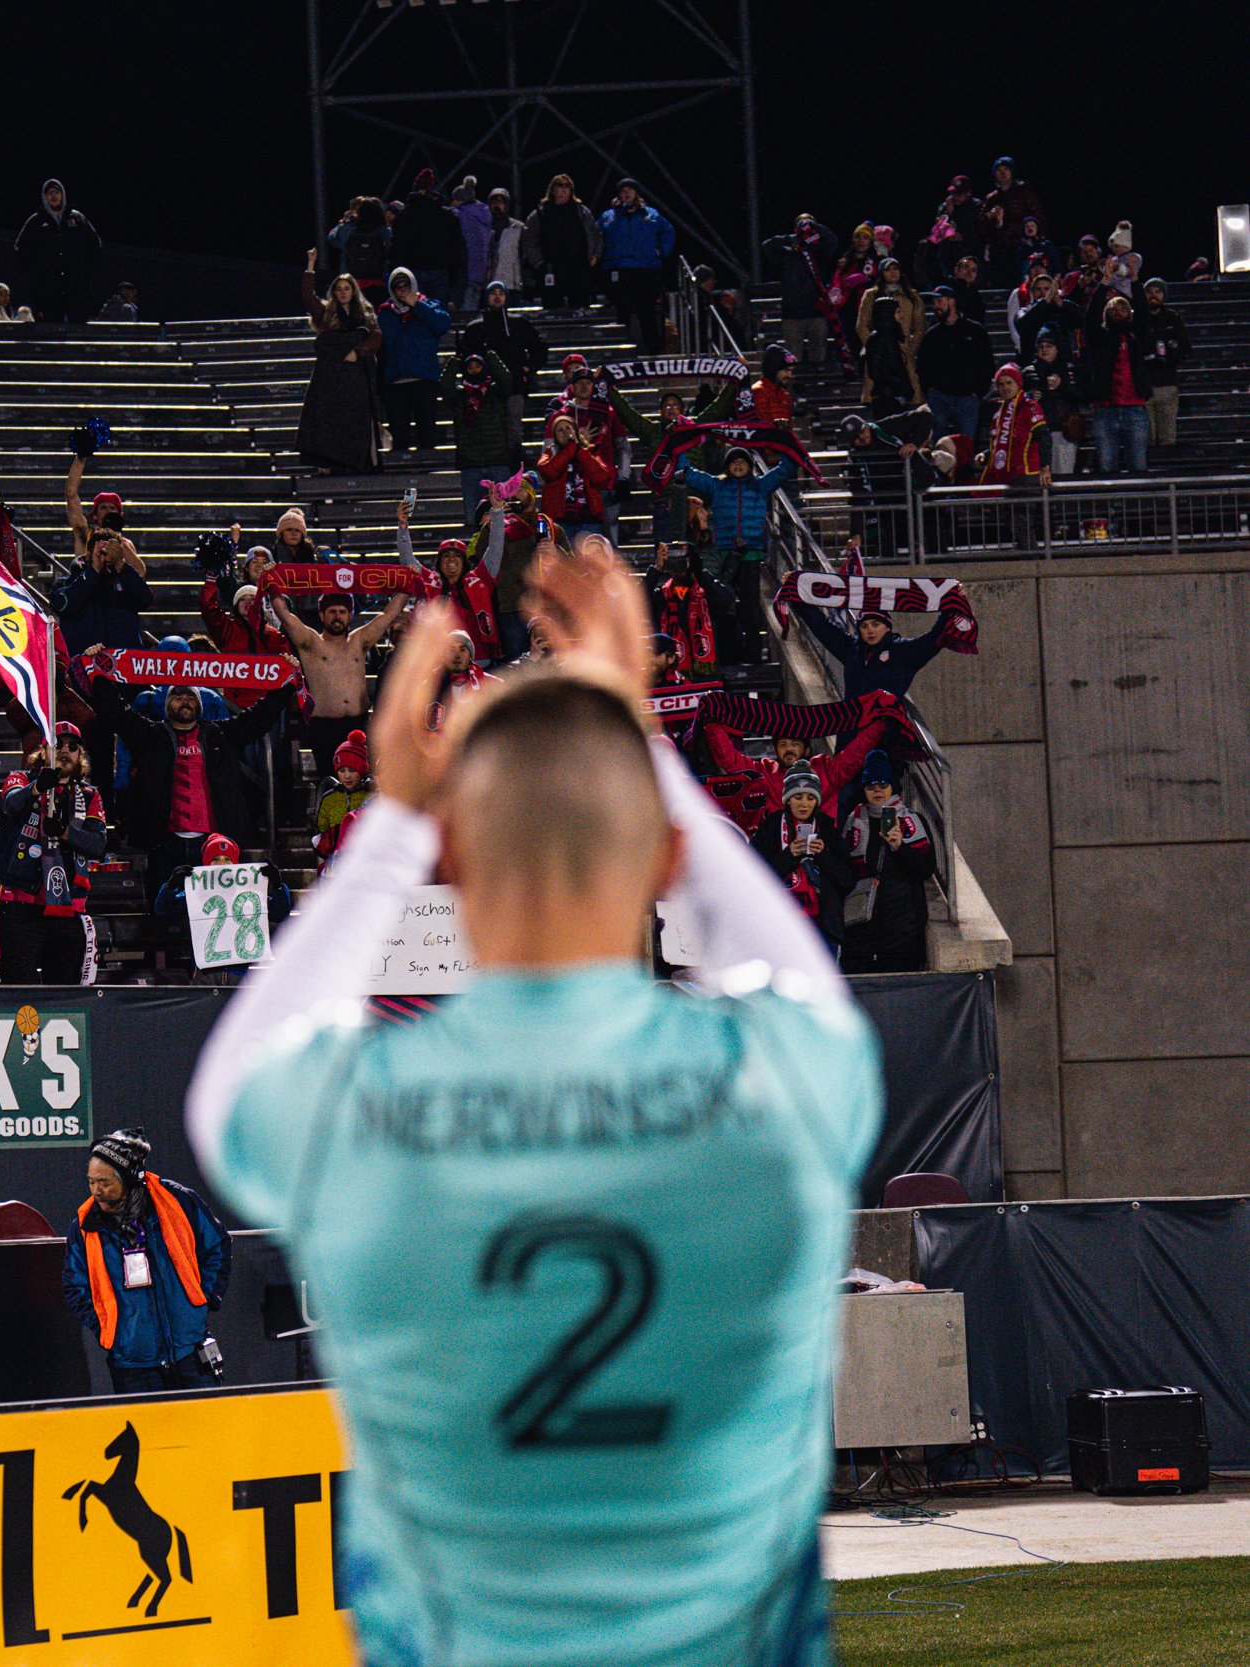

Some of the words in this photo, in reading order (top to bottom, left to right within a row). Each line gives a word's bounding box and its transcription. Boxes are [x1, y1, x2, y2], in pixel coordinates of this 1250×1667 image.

[338, 573, 354, 583] FOR
[797, 572, 958, 612] CITY
[131, 657, 178, 676] WALK
[181, 659, 250, 680] AMONG
[254, 663, 281, 681] US
[191, 866, 262, 891] MIGGY
[202, 891, 266, 963] 28
[409, 960, 430, 976] Sign
[479, 1208, 674, 1450] 2
